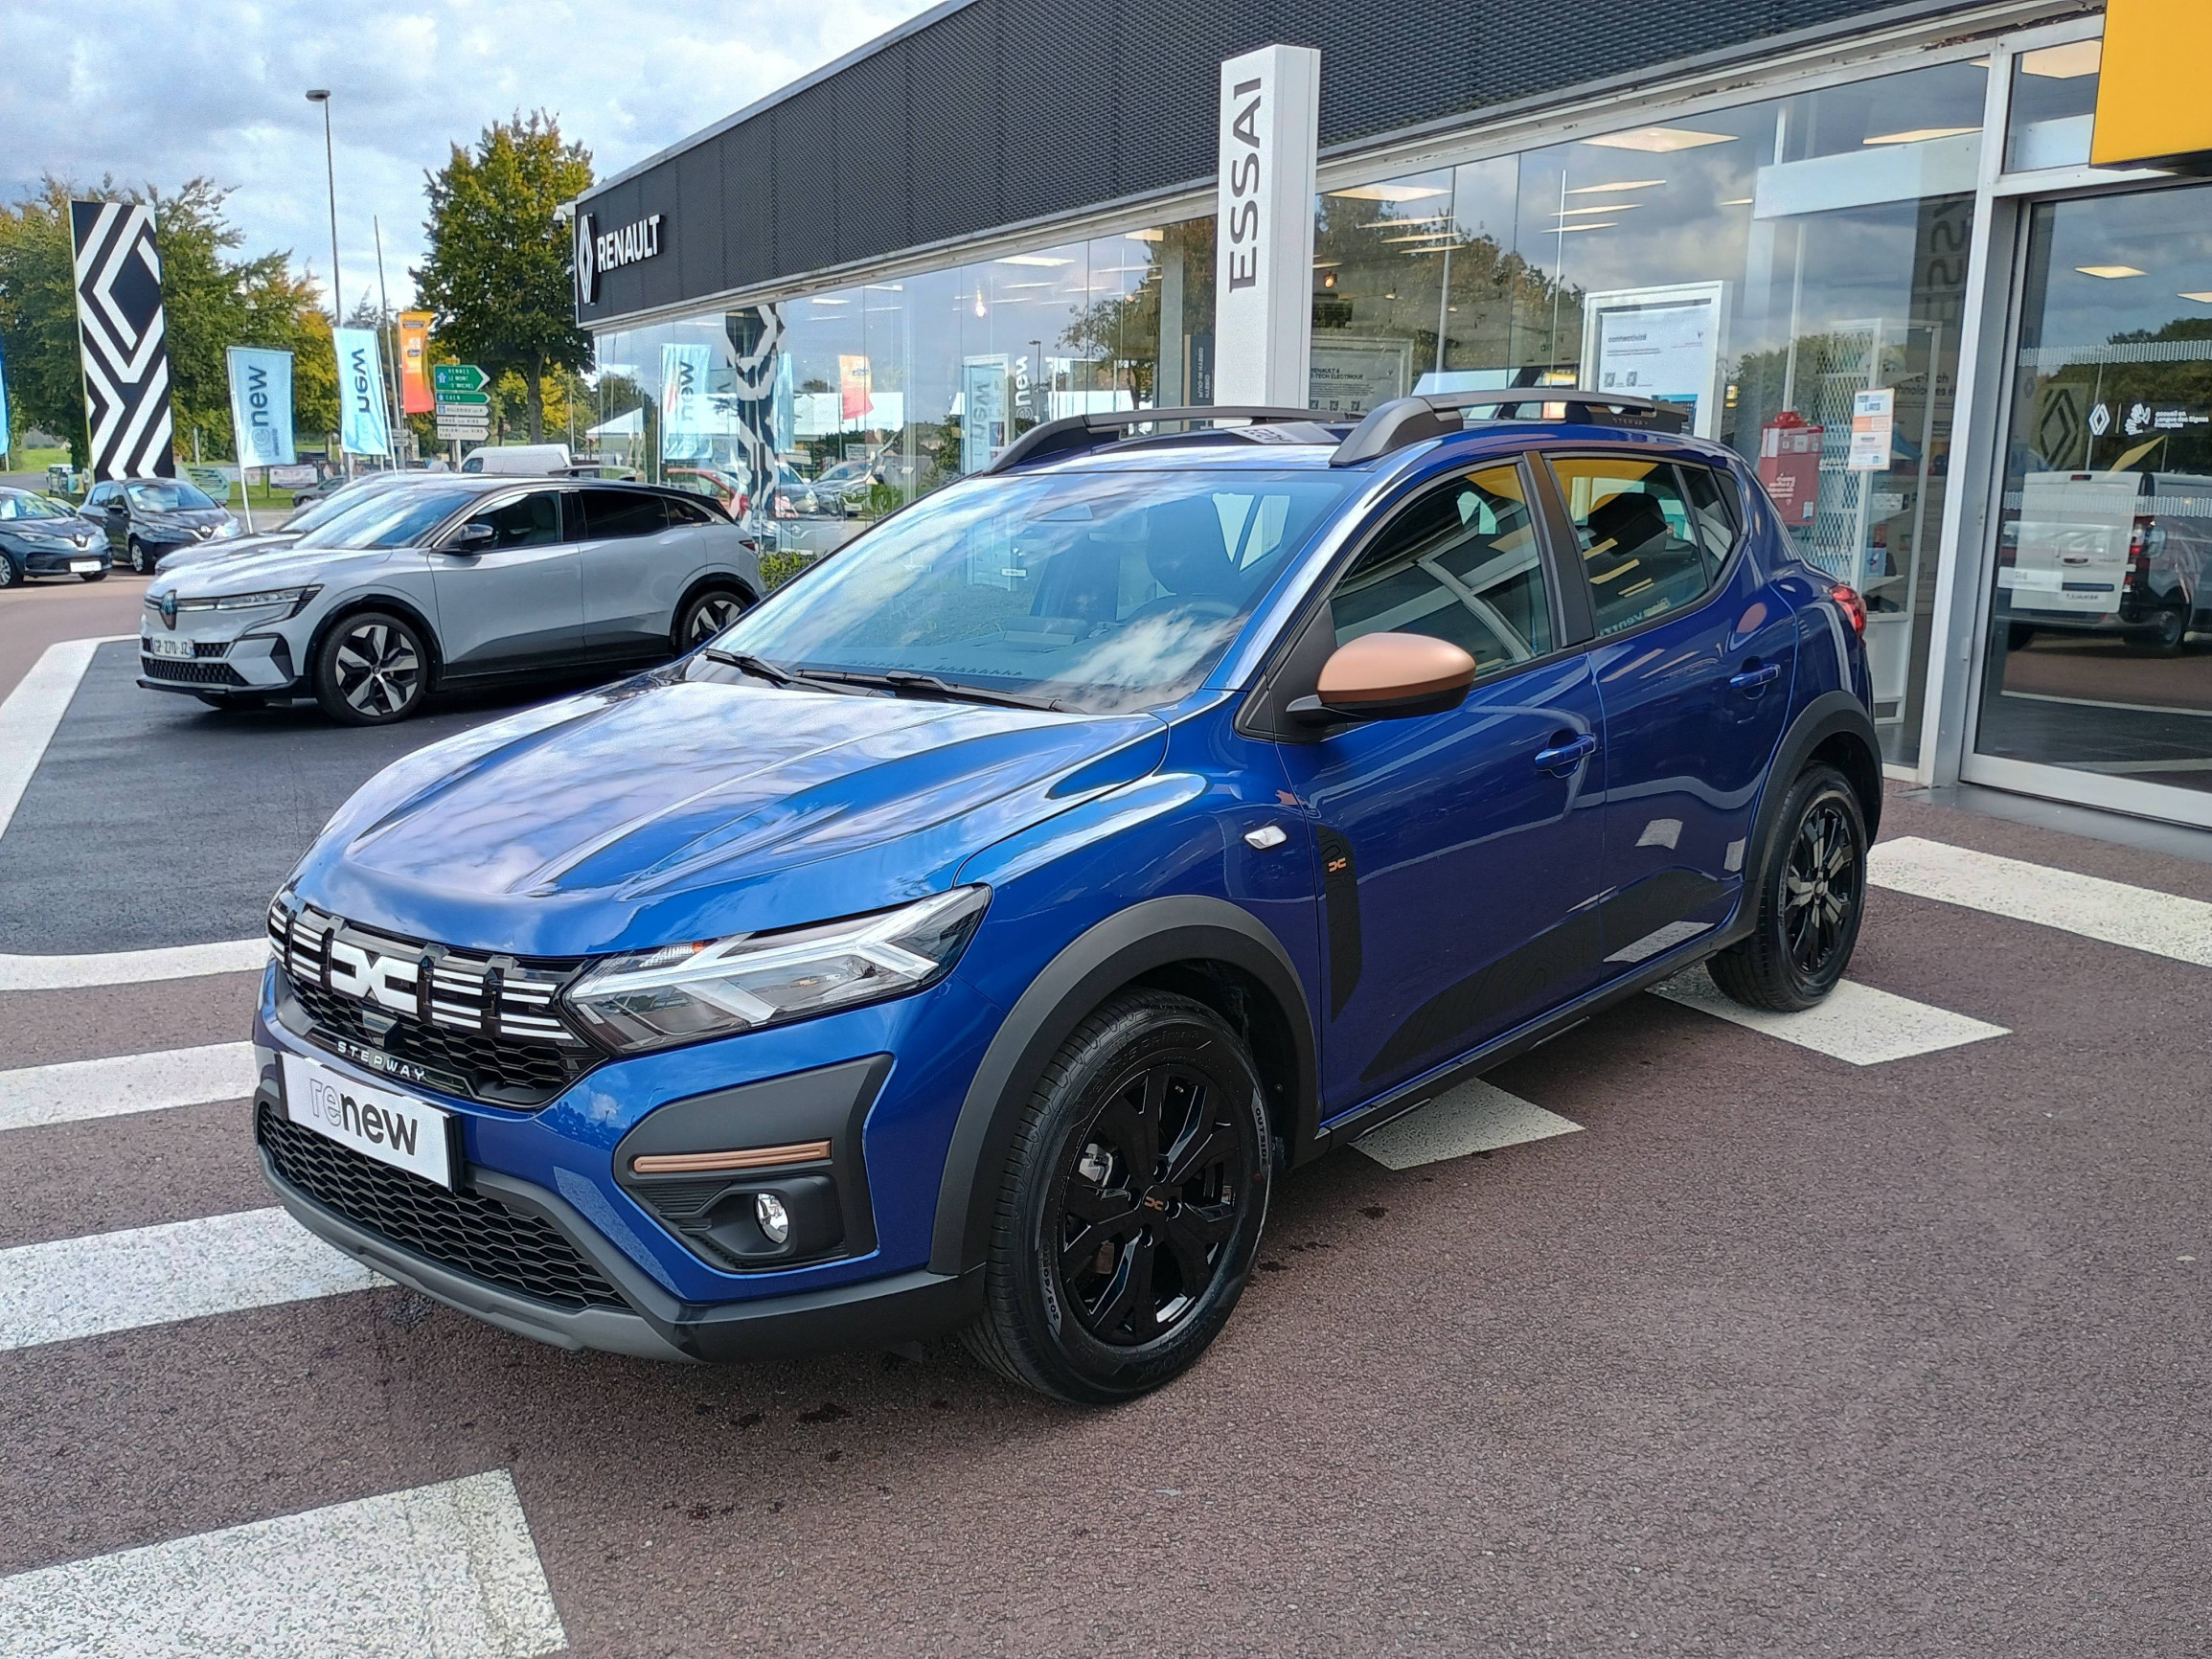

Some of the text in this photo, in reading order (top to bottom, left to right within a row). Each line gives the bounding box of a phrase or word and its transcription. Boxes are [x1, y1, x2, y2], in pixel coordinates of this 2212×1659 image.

[1229, 77, 1262, 294] ESSAI
[597, 213, 660, 273] RENAULT
[337, 1040, 425, 1081] STEPWAY
[309, 1078, 419, 1157] renew
